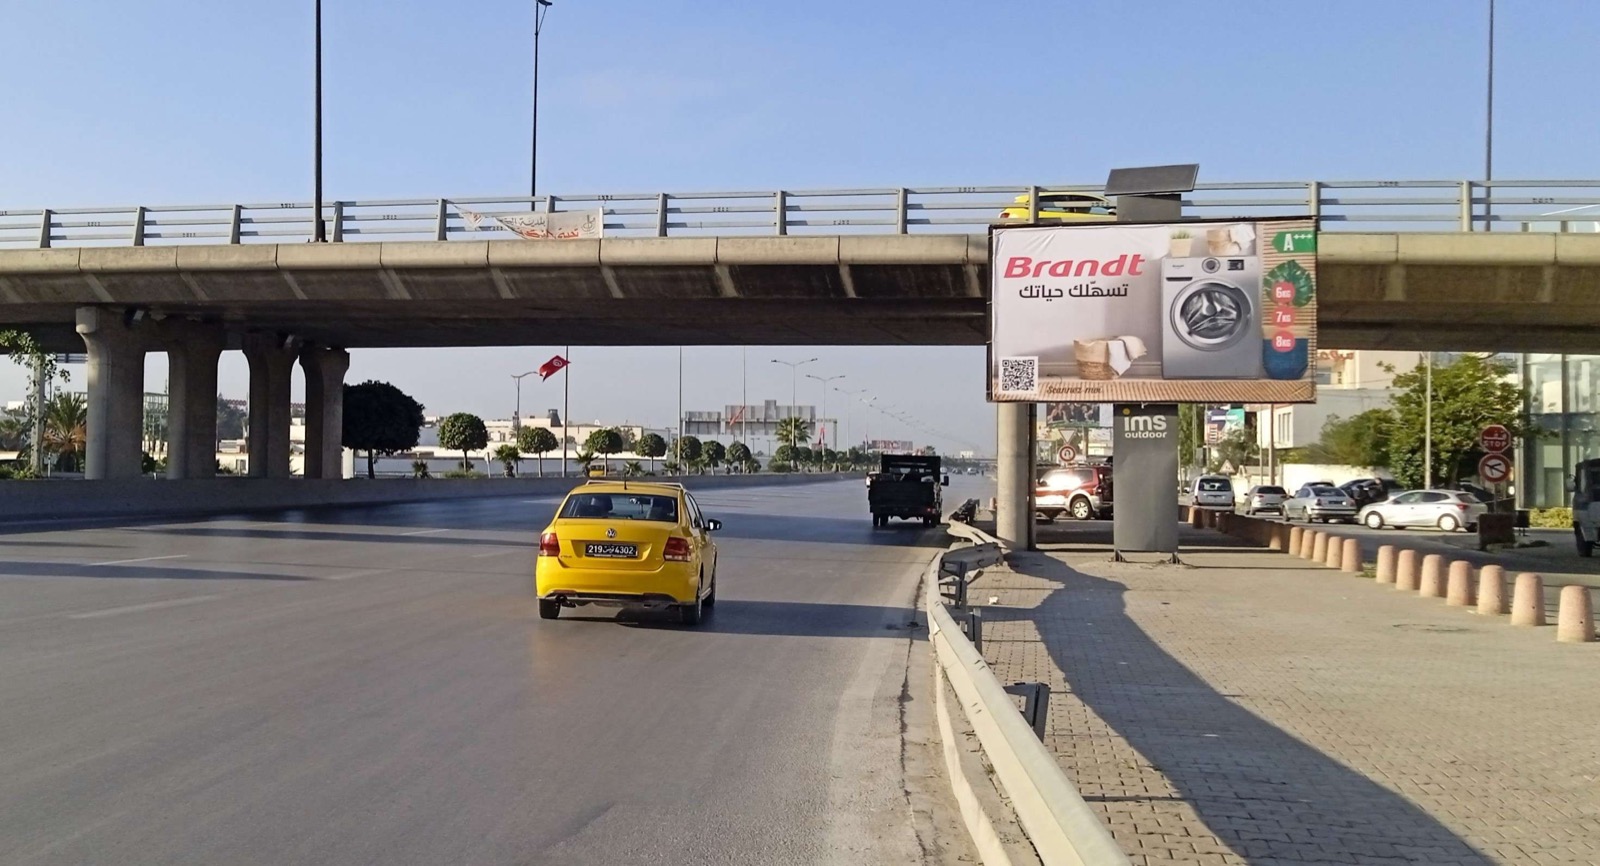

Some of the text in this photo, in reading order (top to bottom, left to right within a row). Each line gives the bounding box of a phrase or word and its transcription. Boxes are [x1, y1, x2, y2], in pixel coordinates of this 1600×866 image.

[1003, 254, 1145, 279] Brandt
[1019, 285, 1063, 301] حياتك
[1122, 408, 1167, 431] ims
[1124, 431, 1168, 439] outdoor
[588, 545, 603, 553] 219
[615, 546, 634, 554] 4302
